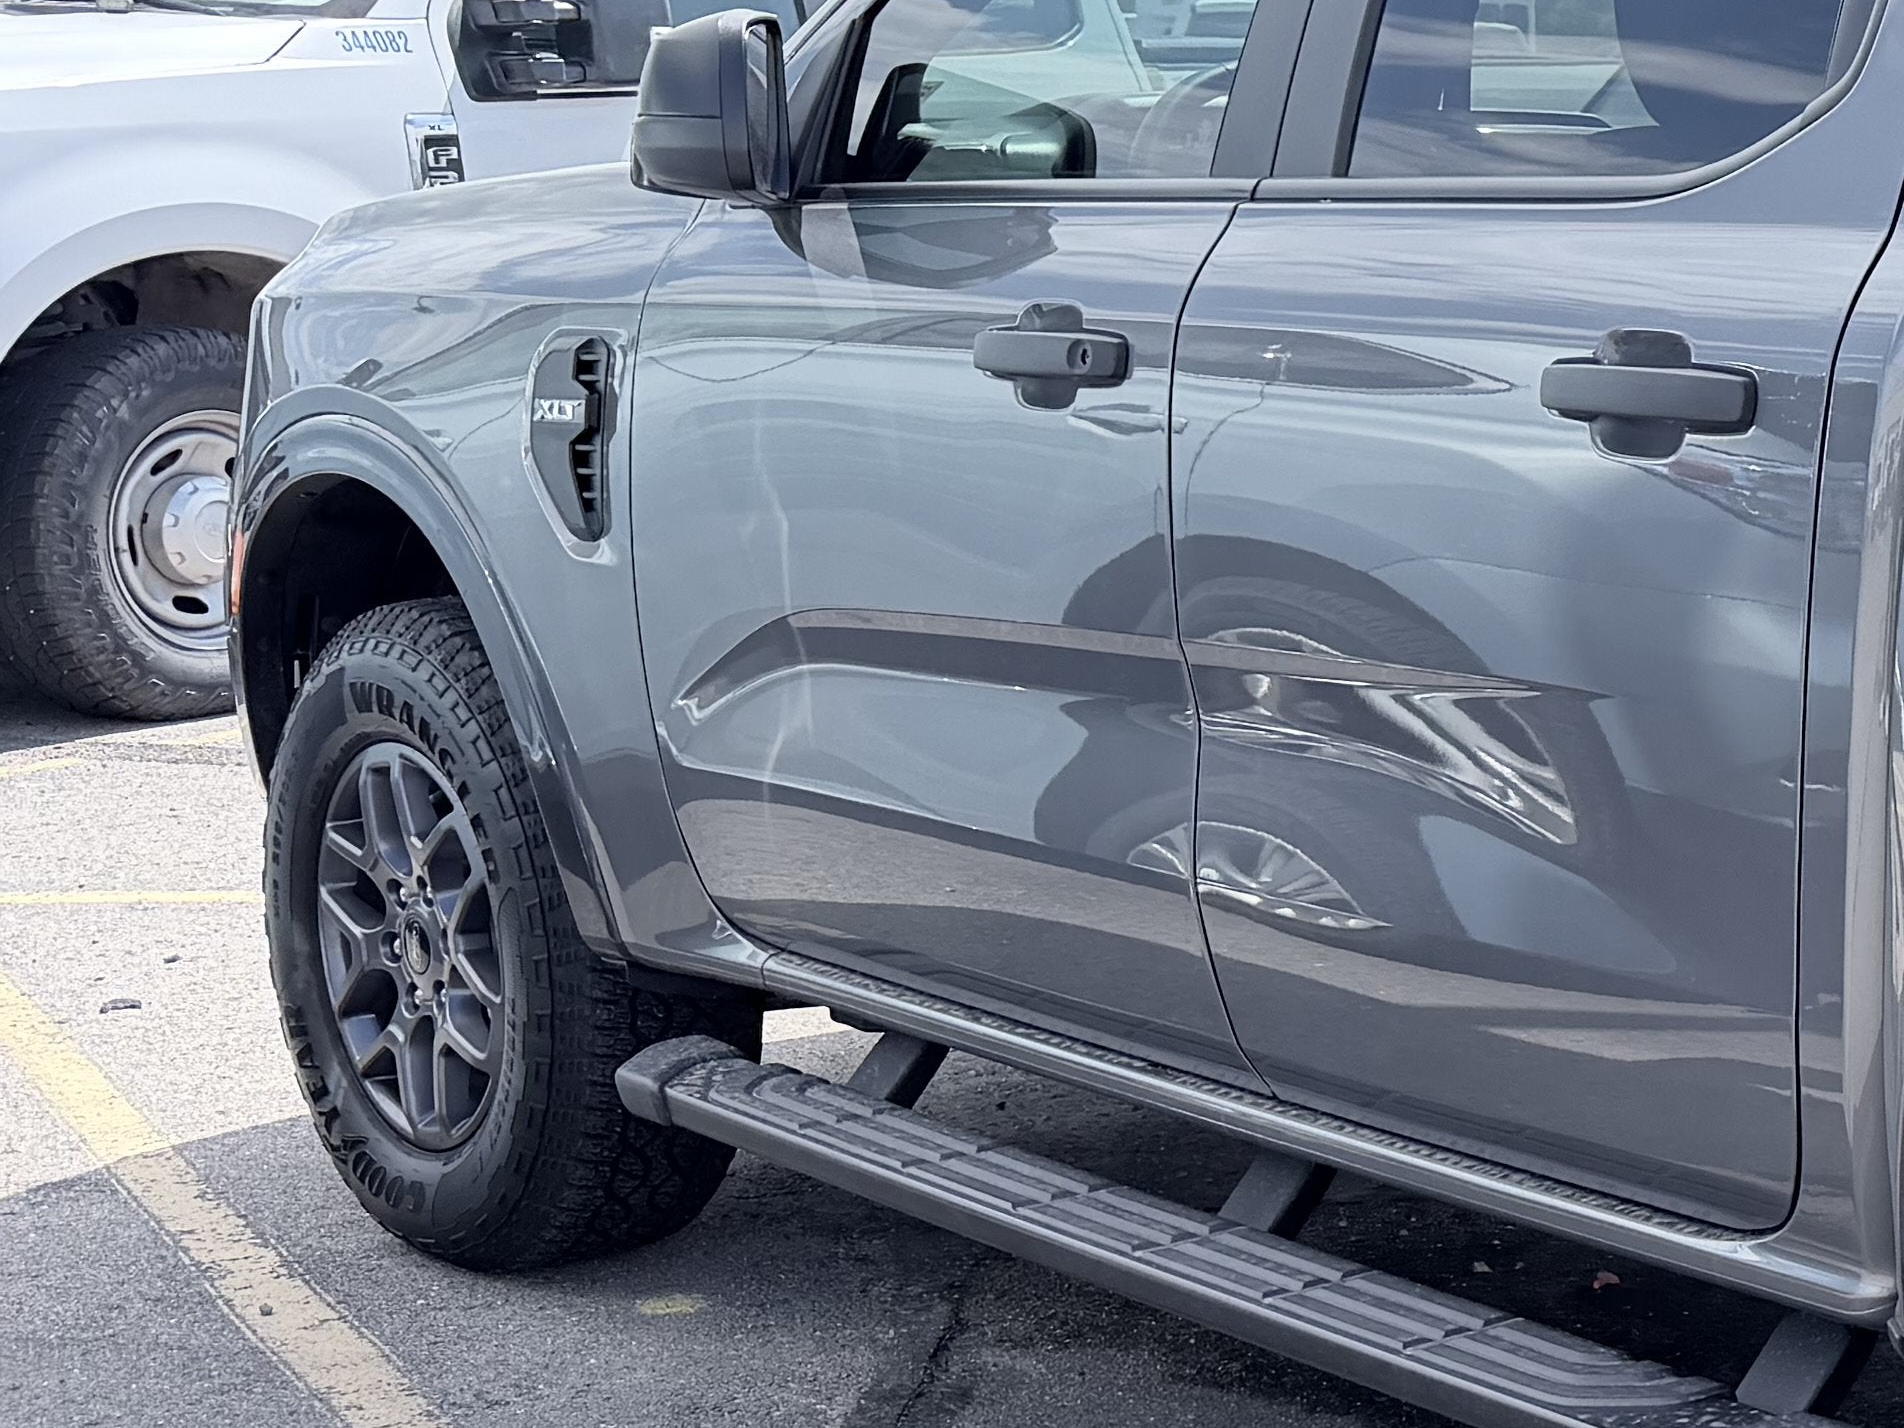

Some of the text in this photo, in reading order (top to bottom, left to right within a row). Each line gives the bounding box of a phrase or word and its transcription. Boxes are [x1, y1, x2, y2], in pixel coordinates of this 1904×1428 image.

[336, 30, 413, 54] 344082
[428, 124, 445, 132] XL
[533, 398, 585, 423] XLT
